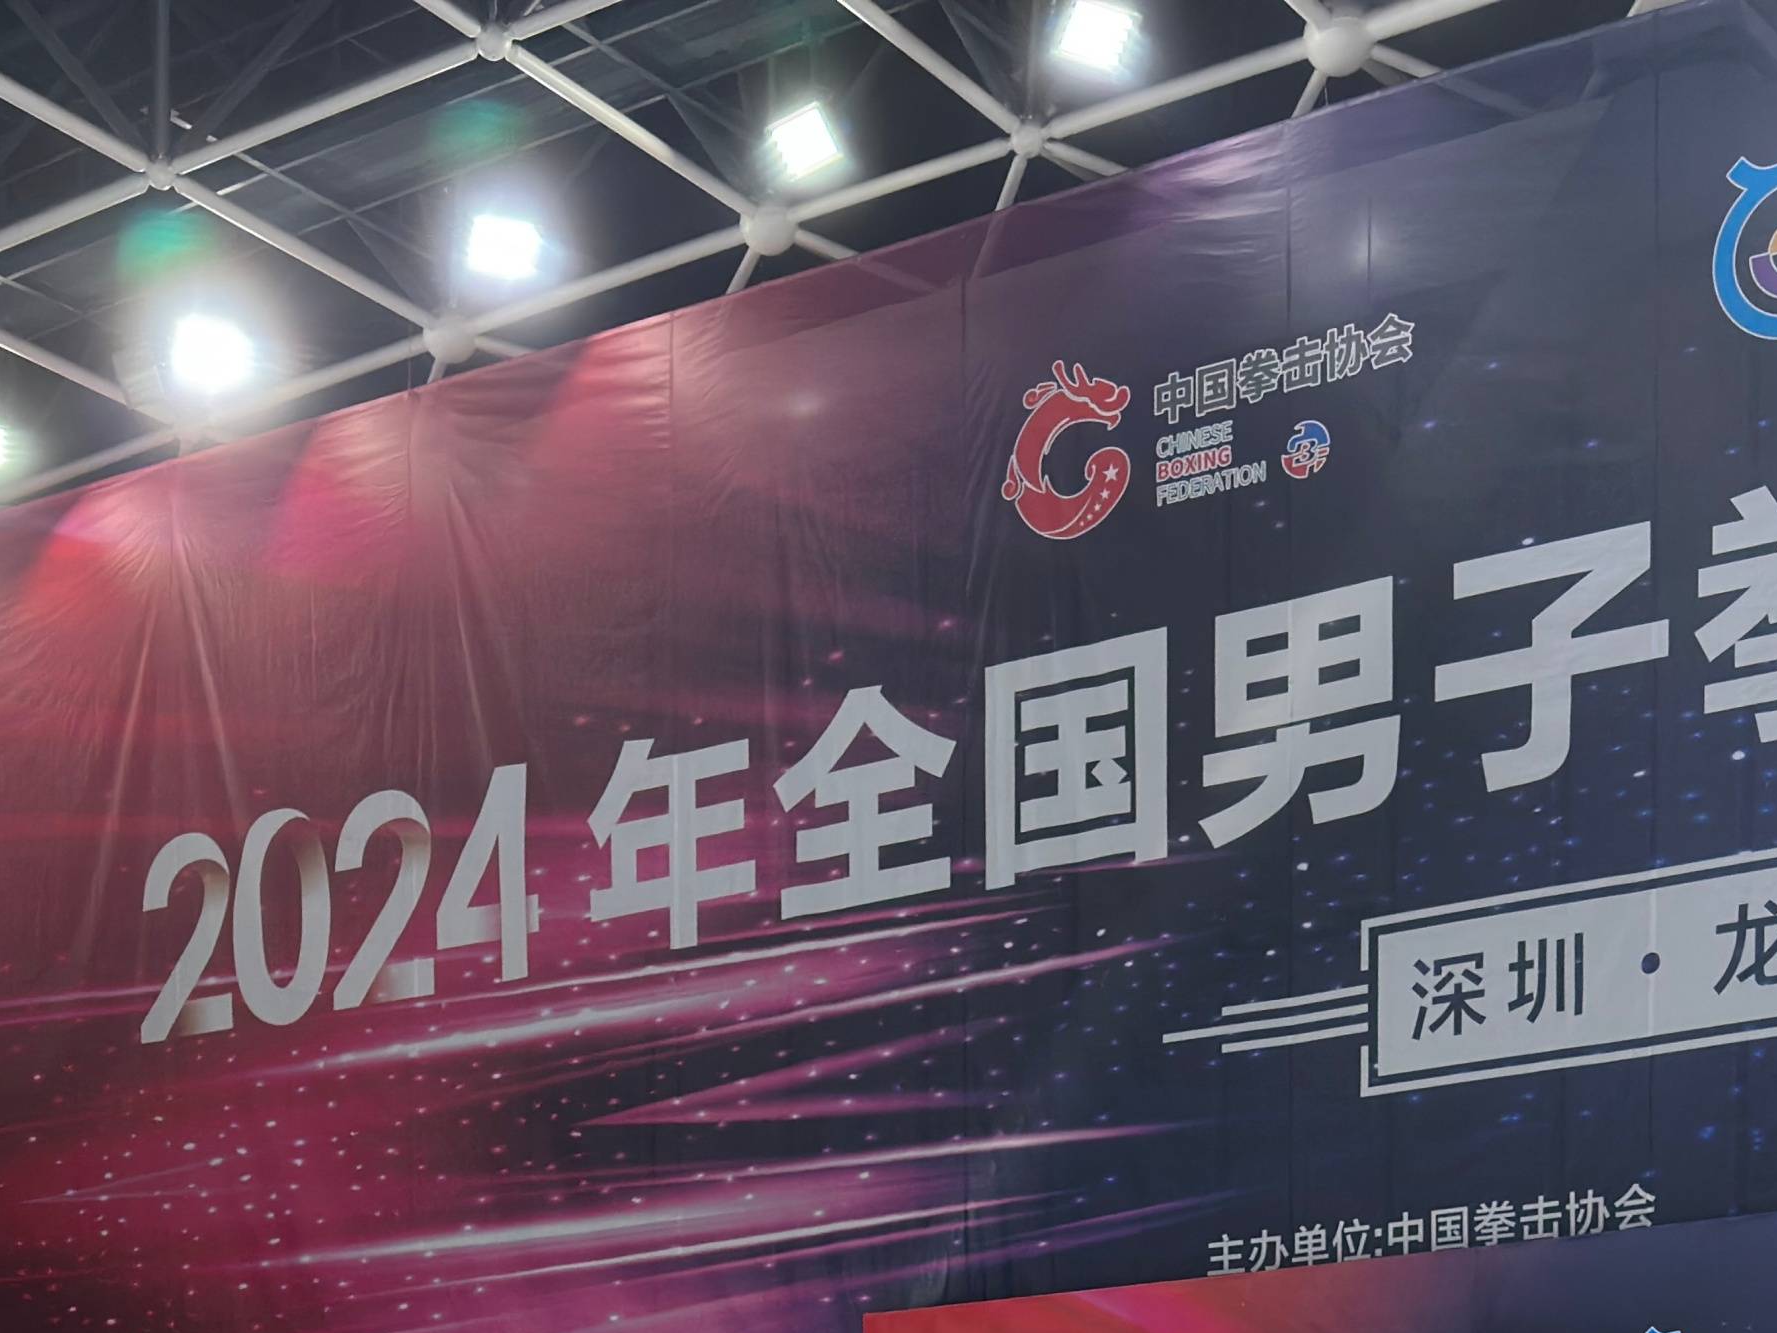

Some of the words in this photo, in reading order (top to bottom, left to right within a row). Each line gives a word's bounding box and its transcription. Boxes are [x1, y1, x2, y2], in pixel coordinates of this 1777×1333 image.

[1154, 313, 1415, 424] 中国拳击协会
[1156, 420, 1233, 459] CHINESE
[1156, 446, 1232, 482] BOXING
[1156, 461, 1267, 506] FEDERATION
[1207, 1183, 1656, 1277] 主办单位:中国拳击协会
